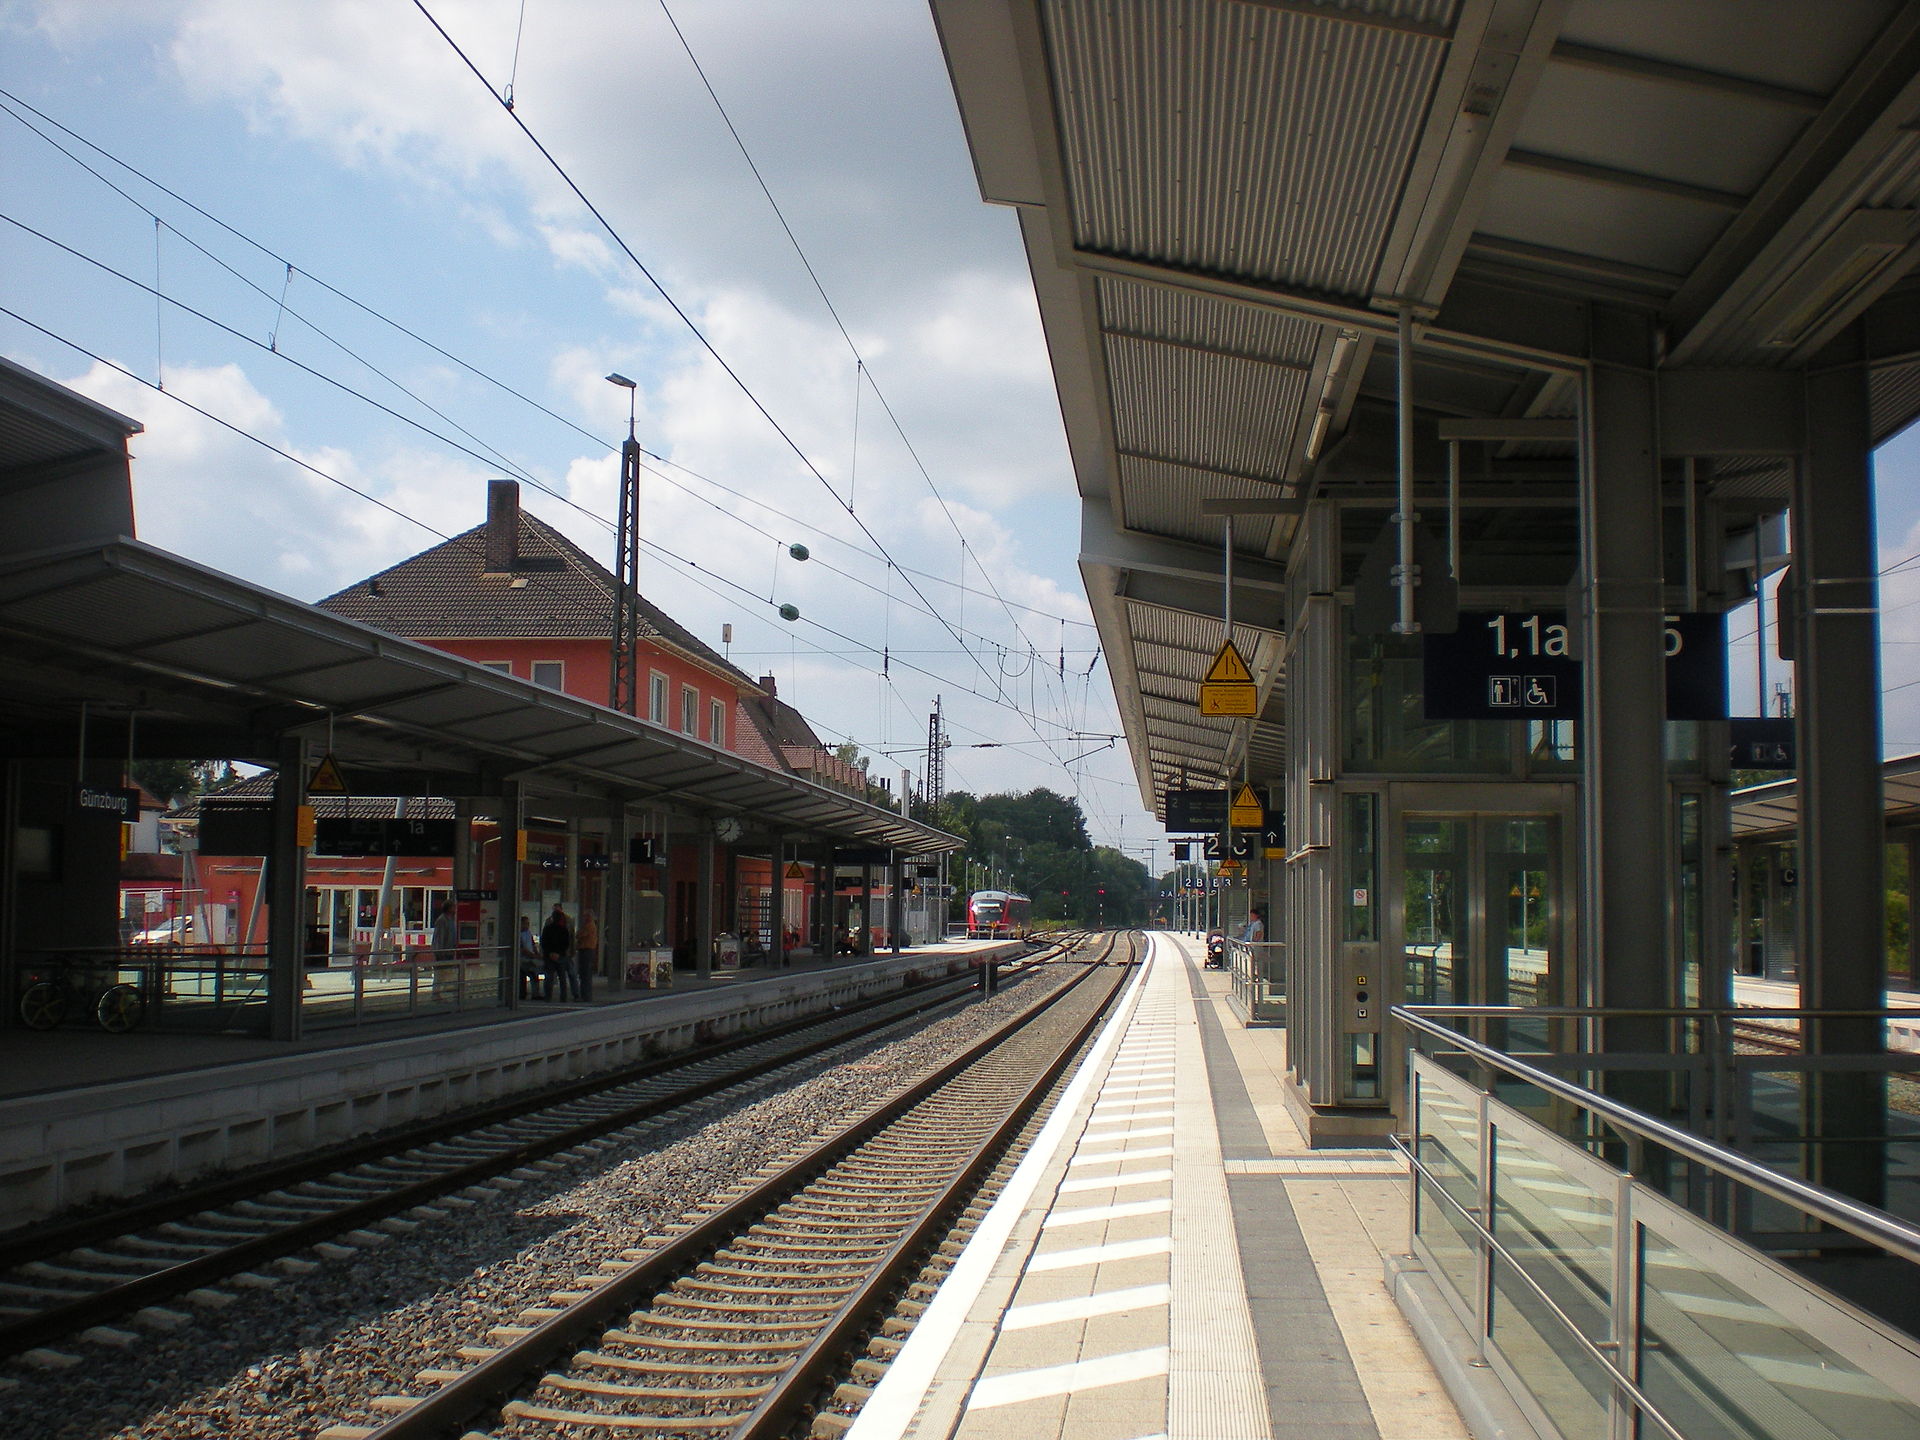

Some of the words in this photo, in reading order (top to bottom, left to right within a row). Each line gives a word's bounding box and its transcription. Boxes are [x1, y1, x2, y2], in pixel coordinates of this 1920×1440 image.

[1487, 614, 1569, 660] 1,1a
[80, 788, 128, 815] Günzburg
[1171, 798, 1179, 808] 2
[408, 820, 425, 835] 1a
[643, 839, 652, 858] 1
[1207, 837, 1220, 855] 2
[1185, 878, 1192, 888] 2
[1196, 878, 1203, 888] B
